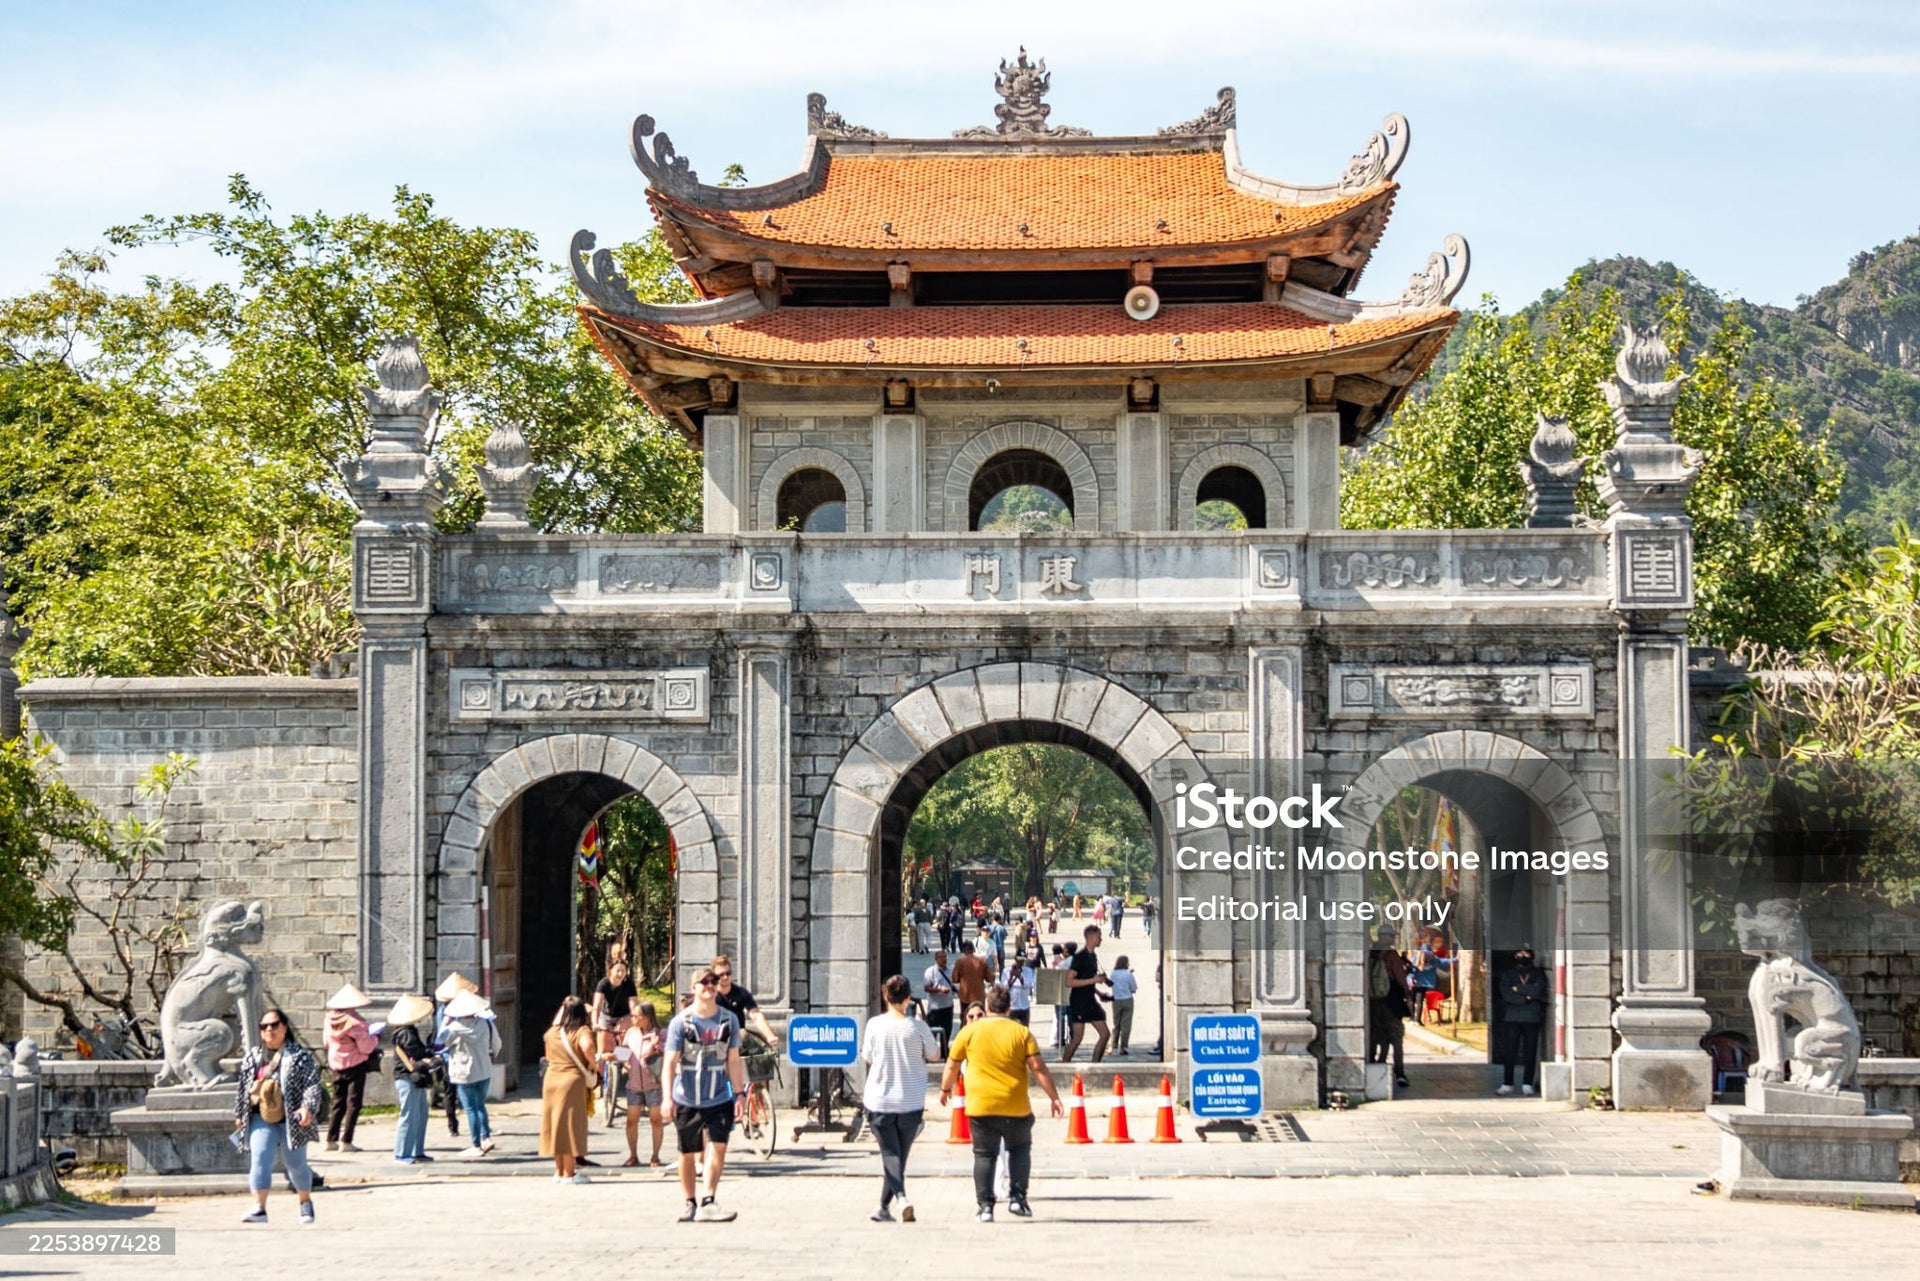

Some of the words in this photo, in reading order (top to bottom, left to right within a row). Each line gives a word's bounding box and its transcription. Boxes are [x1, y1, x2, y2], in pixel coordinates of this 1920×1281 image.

[836, 1027, 855, 1042] SINH
[1200, 1045, 1225, 1055] Check
[1226, 1045, 1249, 1054] Ticket
[1207, 1096, 1247, 1105] Entrance
